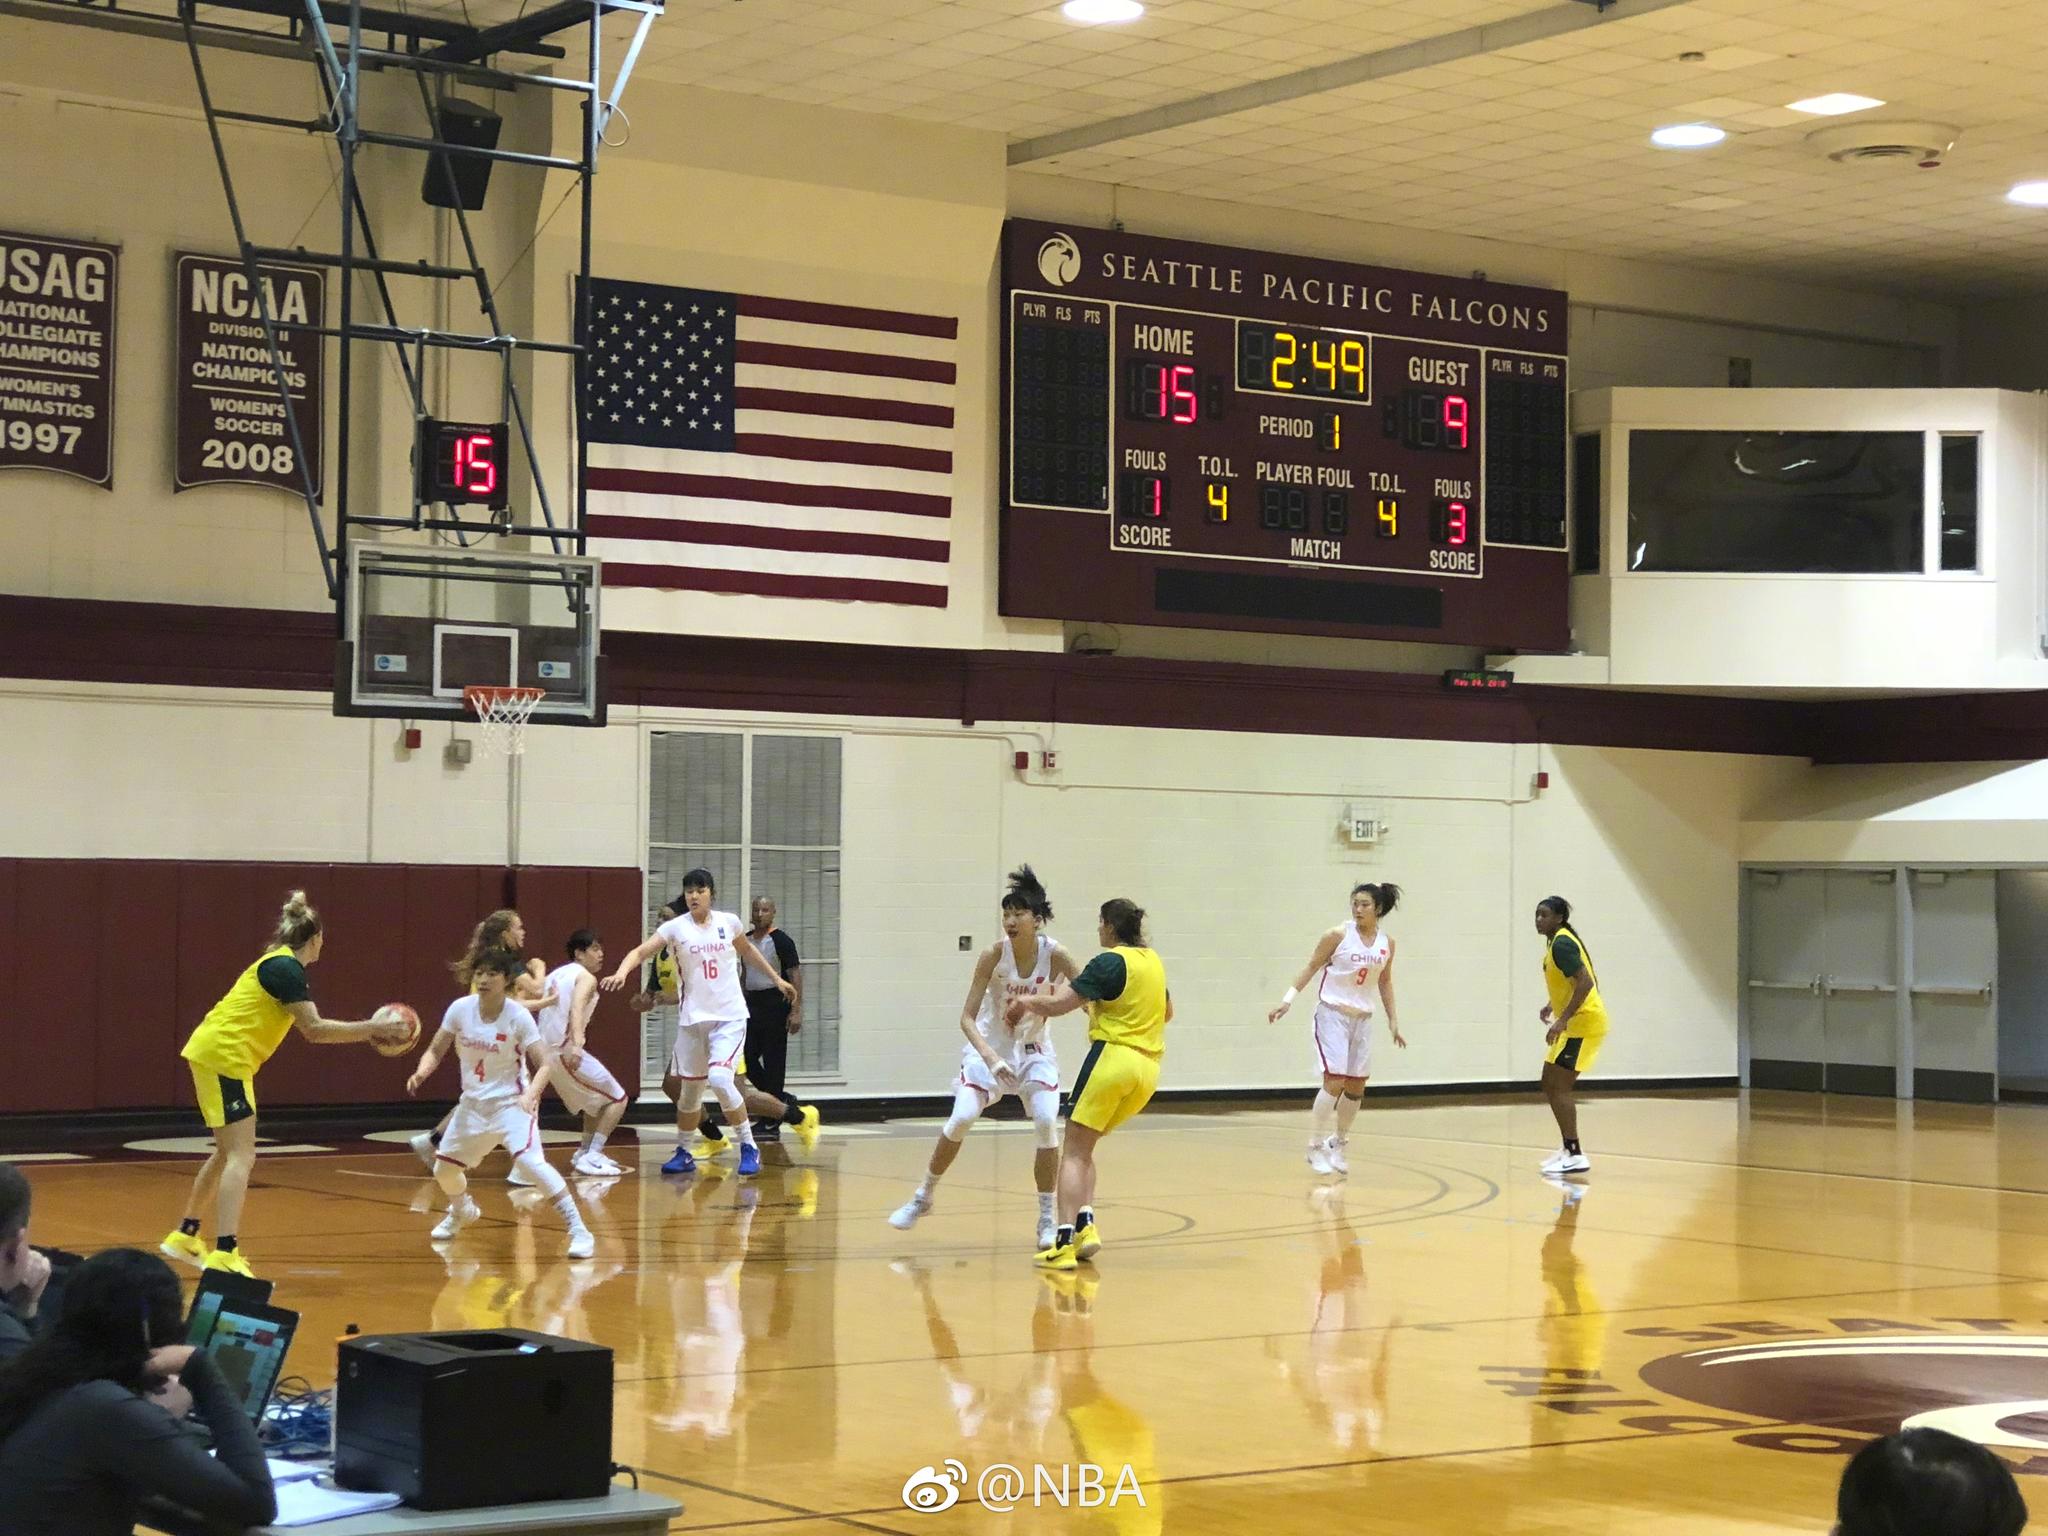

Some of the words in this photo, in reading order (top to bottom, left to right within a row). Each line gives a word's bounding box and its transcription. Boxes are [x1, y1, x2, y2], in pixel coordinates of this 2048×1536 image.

[0, 246, 105, 302] SAG
[192, 268, 308, 324] NCAA
[1102, 253, 1243, 294] SEATTLE
[1263, 273, 1392, 313] PACIFIC
[1411, 292, 1548, 332] FALCONS
[1023, 302, 1046, 318] PLYR
[1055, 306, 1072, 321] FLS
[1084, 309, 1101, 325] PTS
[0, 322, 103, 348] OLLEGIATE
[209, 322, 274, 339] DIVISIO
[279, 330, 289, 341] II
[1134, 323, 1194, 356] HOME
[0, 343, 100, 368] HAMPIONS
[1272, 332, 1365, 394] 2:49
[1408, 356, 1469, 387] GUEST
[1492, 358, 1512, 373] PLYR
[1520, 362, 1534, 376] FLS
[1544, 365, 1558, 378] PTS
[1160, 366, 1197, 423] 15
[0, 396, 95, 419] MNASTICS
[210, 397, 286, 418] WOMEN'S
[214, 417, 284, 436] SOCCER
[1260, 415, 1313, 439] PERIOD
[1334, 414, 1340, 450] 1
[1444, 395, 1468, 449] 9
[202, 439, 294, 474] 2008
[454, 437, 496, 493] 15
[1125, 449, 1167, 471] FOULS
[1198, 456, 1239, 478] T.O.L.
[1256, 461, 1312, 485] PLAYER
[1317, 467, 1354, 489] FOUL
[1369, 472, 1406, 494] T.O.L.
[1153, 479, 1161, 516] 1
[1435, 479, 1471, 500] FOULS
[1208, 484, 1228, 521] 4
[1379, 500, 1396, 536] 4
[1449, 502, 1467, 545] 3
[1120, 524, 1171, 547] SCORE
[1291, 538, 1341, 560] MATCH
[1430, 550, 1476, 571] SCORE
[690, 943, 725, 954] CHINA
[1350, 953, 1382, 964] CHINA
[702, 959, 718, 979] 16
[1356, 967, 1369, 985] 9
[474, 1059, 485, 1082] 4
[1624, 1318, 2048, 1342] SEAT
